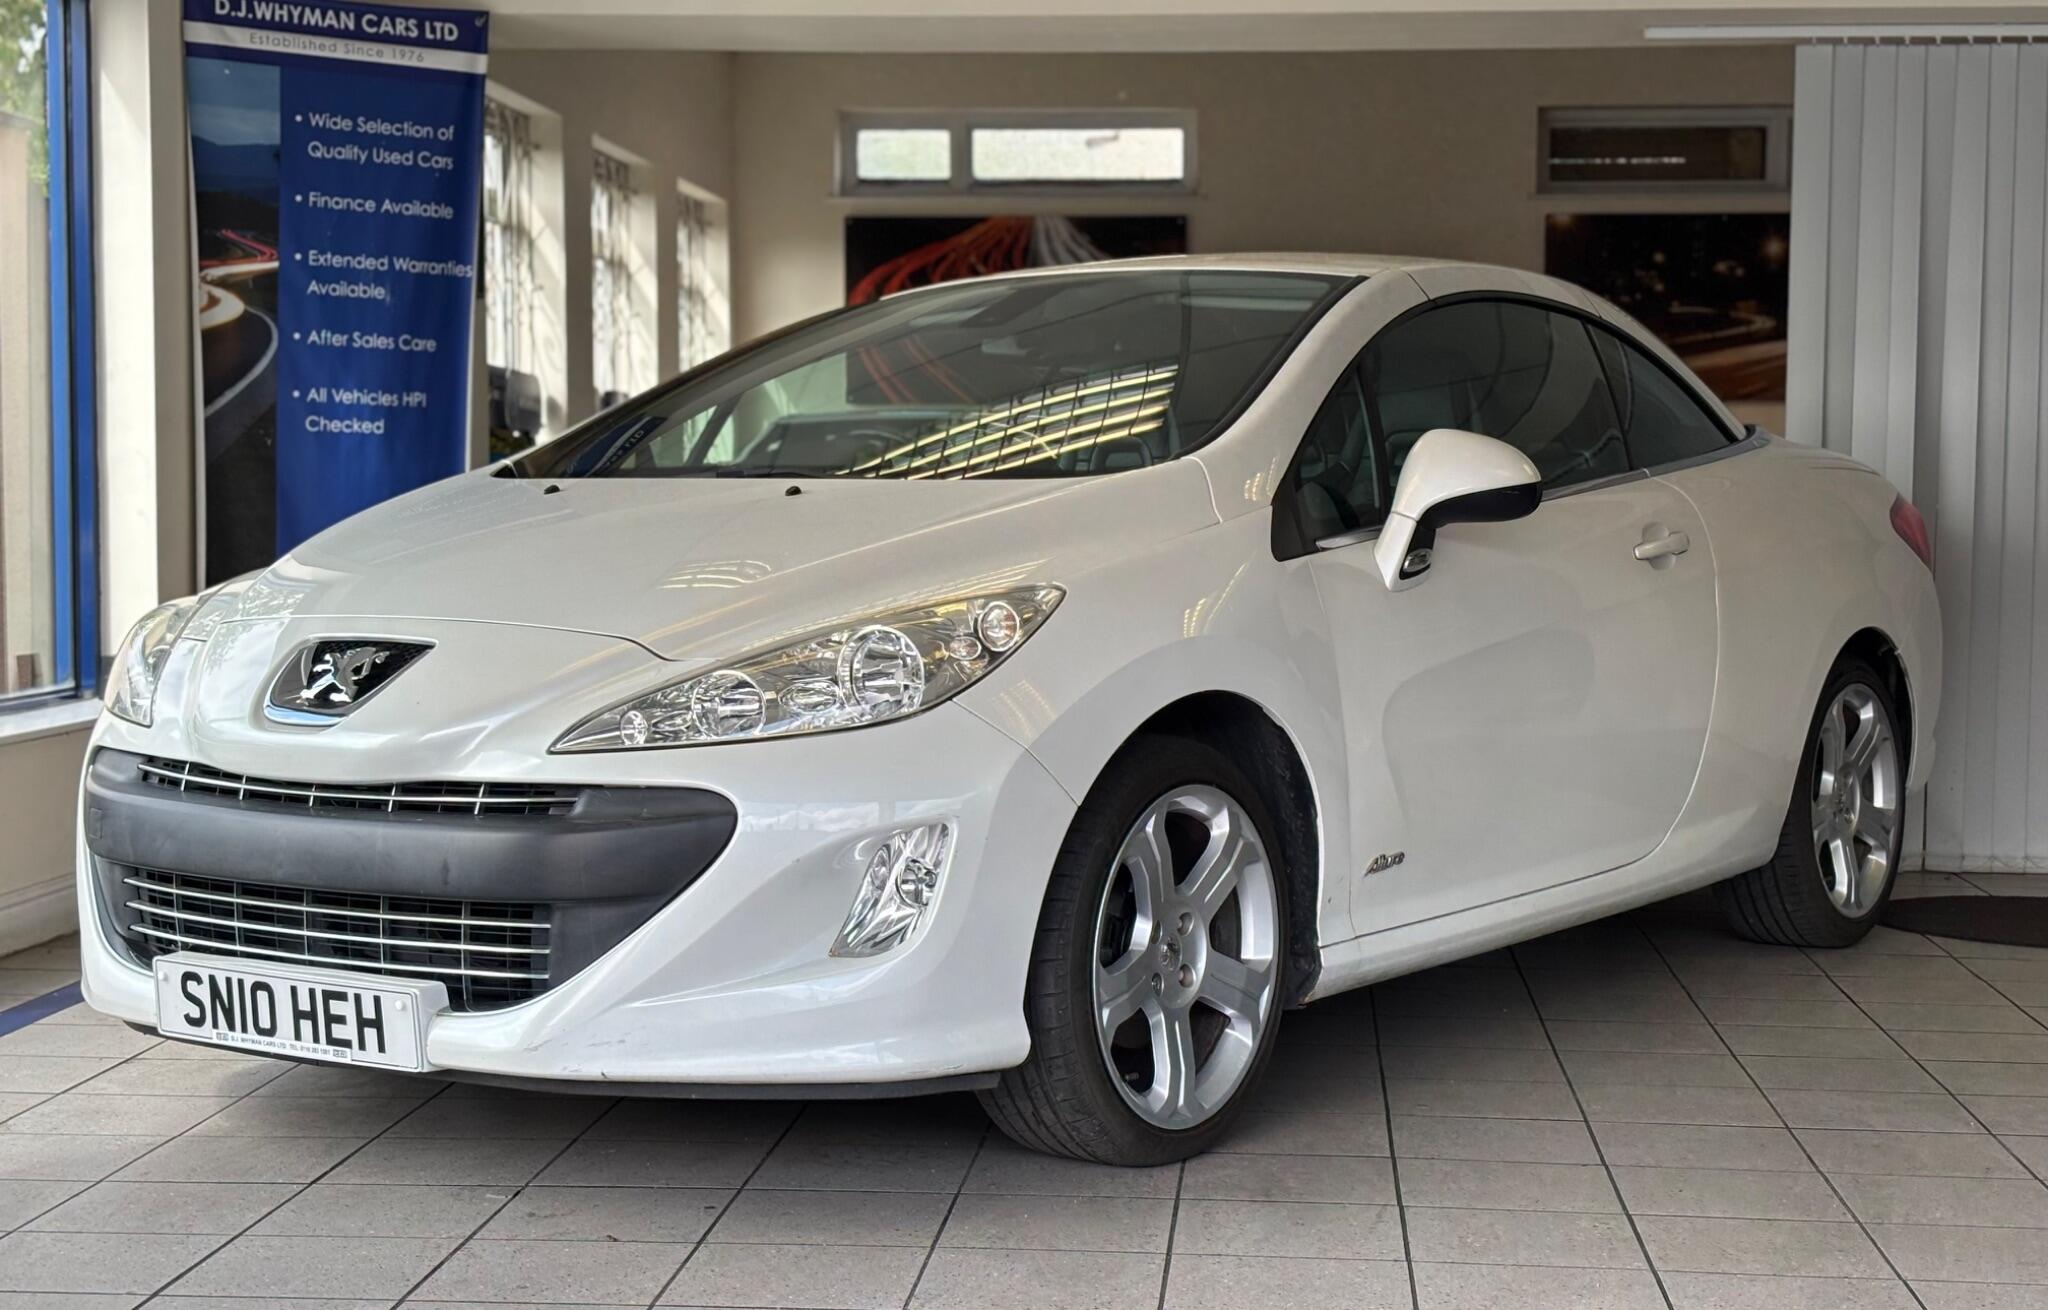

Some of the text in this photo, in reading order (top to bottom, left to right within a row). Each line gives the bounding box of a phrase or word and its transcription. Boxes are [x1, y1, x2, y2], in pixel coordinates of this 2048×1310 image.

[361, 13, 418, 39] CARS
[424, 20, 459, 42] LTD
[249, 32, 424, 63] Established Since 1976
[308, 112, 455, 141] Wide Selection of
[307, 141, 454, 170] Quality Used Cars
[308, 192, 453, 219] Finance Available
[308, 250, 473, 278] Extended Warranties
[306, 280, 386, 301] Available
[306, 330, 437, 352] After Sales Care
[306, 388, 427, 407] All Vehicles HPI
[305, 415, 385, 434] Checked
[180, 971, 387, 1054] SN10 HEH
